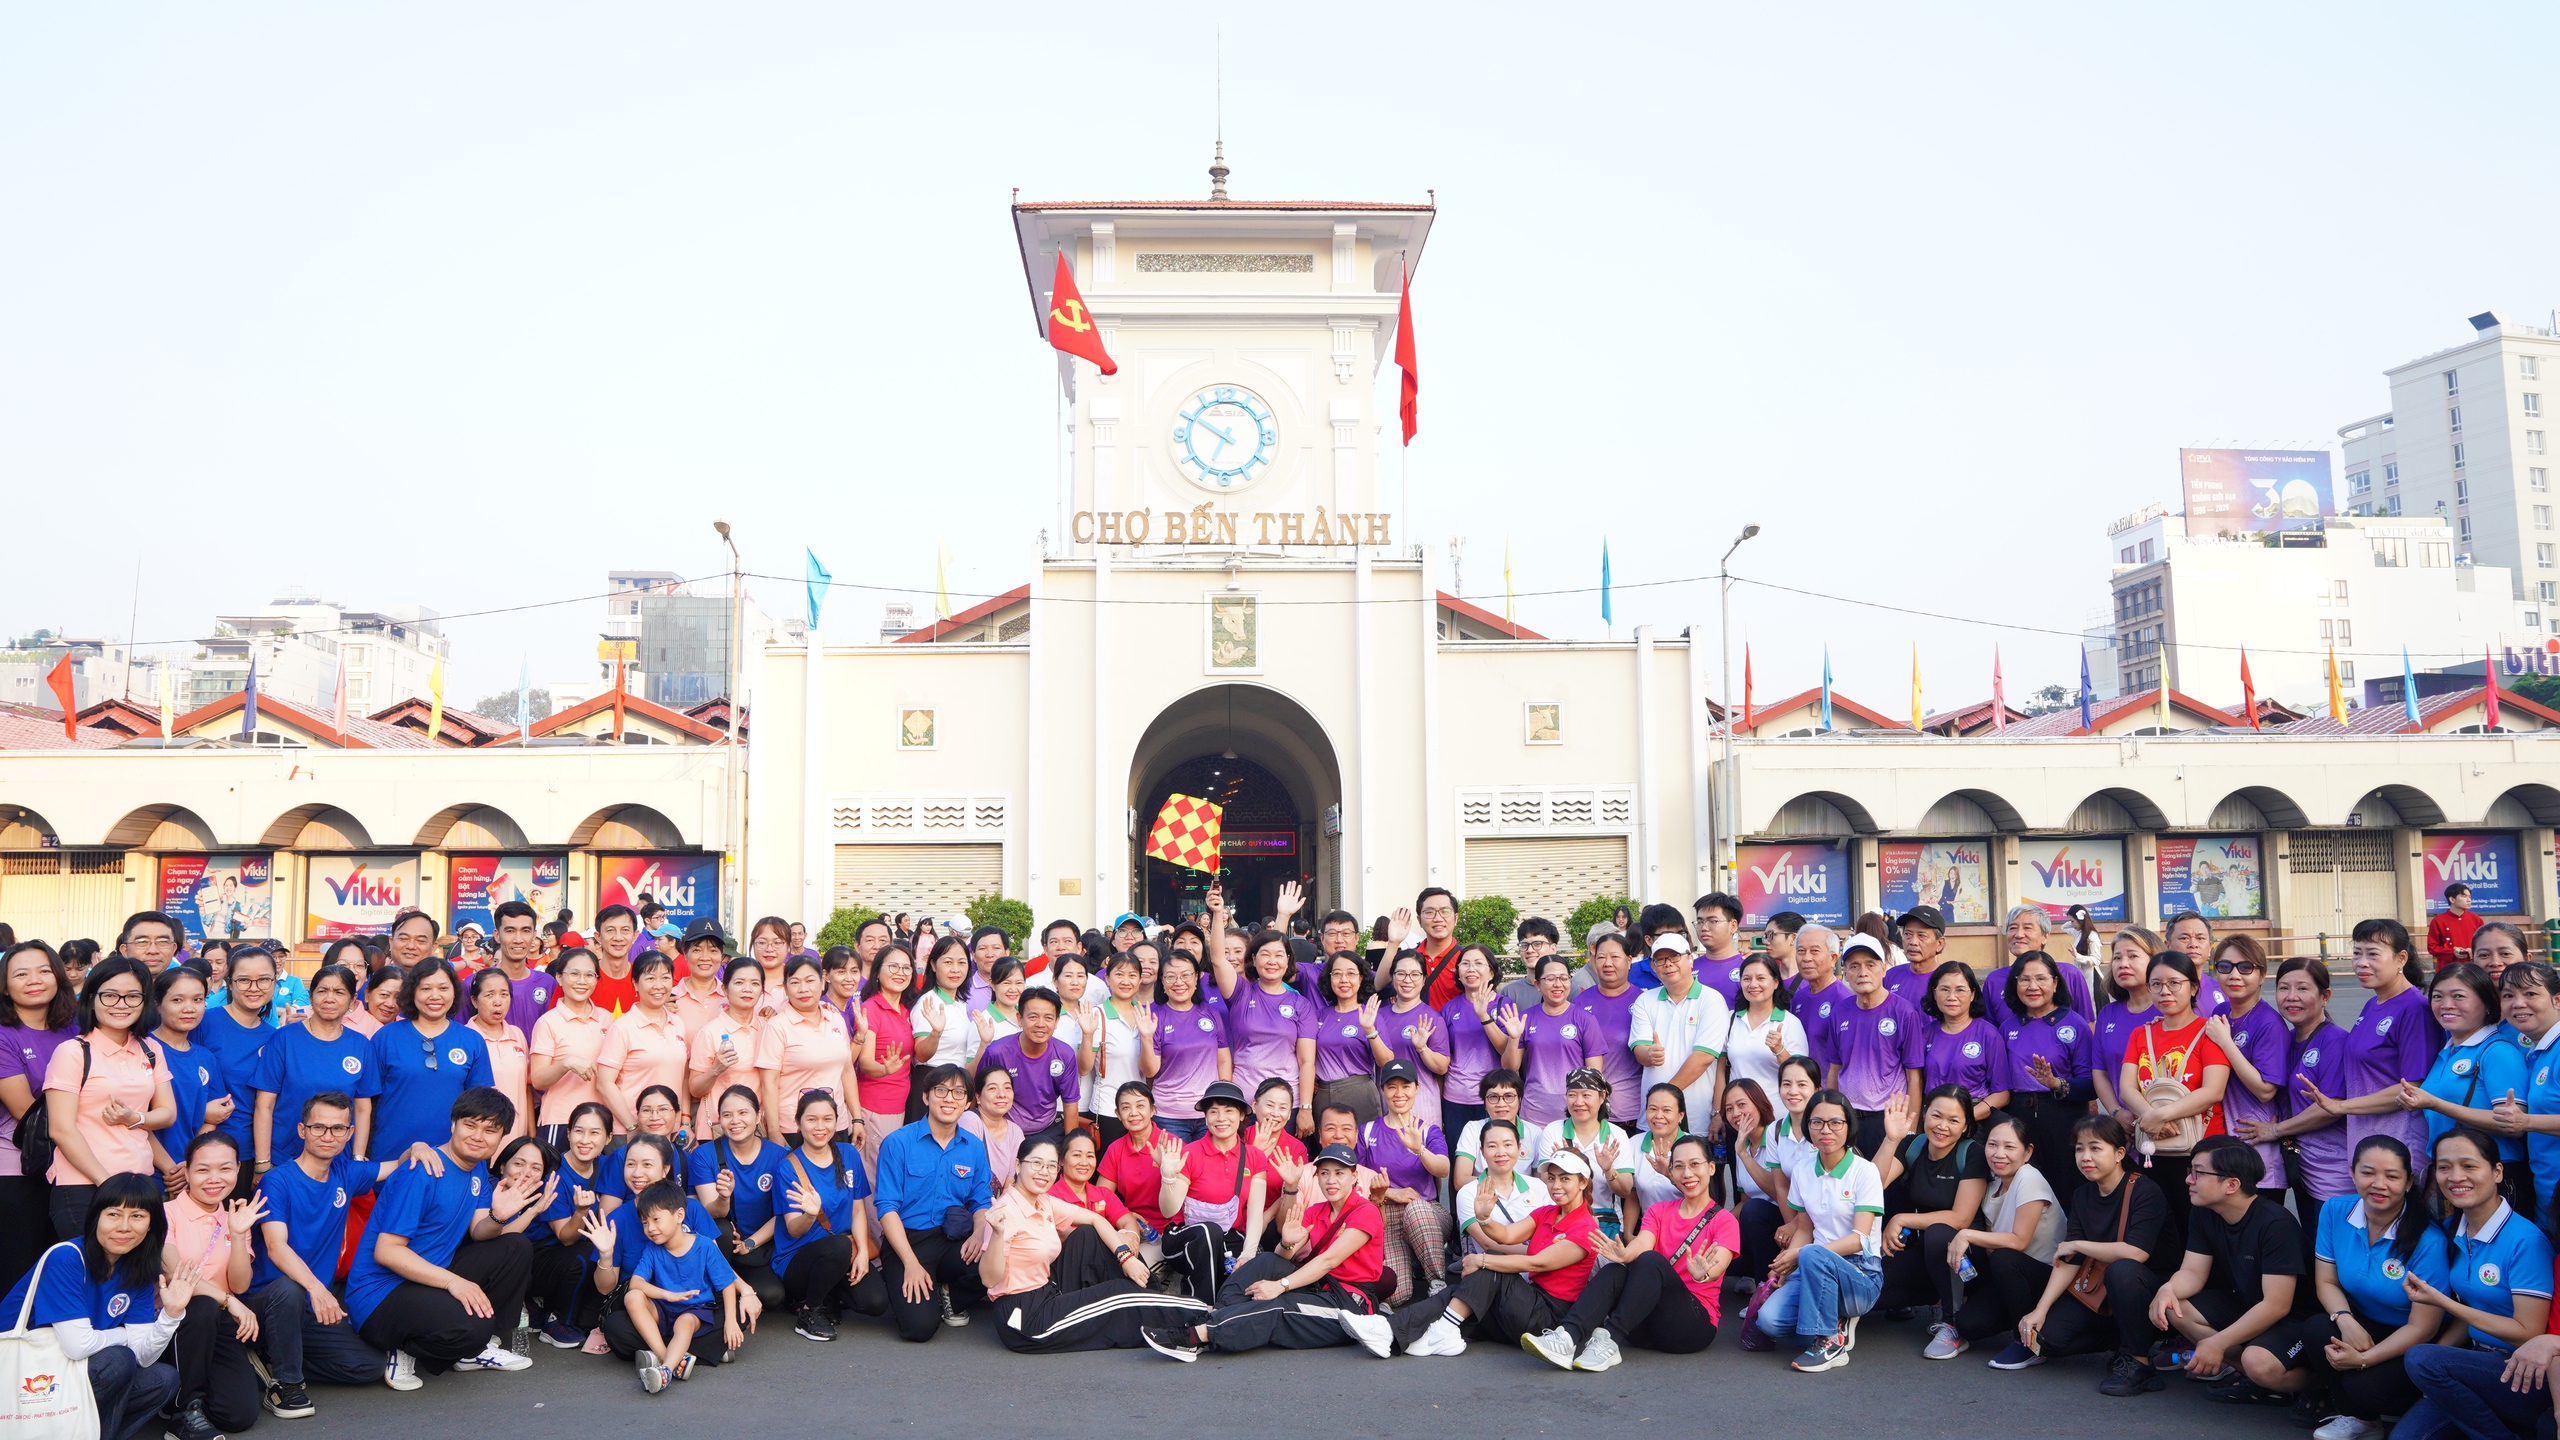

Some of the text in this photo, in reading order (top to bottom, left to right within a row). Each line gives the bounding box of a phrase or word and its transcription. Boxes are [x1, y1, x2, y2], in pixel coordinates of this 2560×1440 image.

[1215, 387, 1237, 402] 12
[1173, 426, 1189, 443] 9
[1261, 429, 1276, 446] 3
[1217, 472, 1231, 487] 6
[2204, 481, 2223, 490] PHONG
[2192, 492, 2211, 502] KHÔNG
[2225, 493, 2236, 502] HẠN
[2215, 504, 2230, 512] 2026
[1072, 501, 1391, 548] CHỢ BẾN THÀNH
[2373, 528, 2410, 537] HOTEL
[2424, 528, 2446, 537] LAC
[2353, 815, 2361, 825] 16
[52, 836, 58, 846] 2
[1227, 839, 1247, 847] CHÀO
[1248, 839, 1262, 847] QUÝ
[1263, 839, 1288, 847] KHÁCH
[1946, 844, 1979, 864] Vikki
[2219, 839, 2252, 859] Vikki
[1885, 857, 1916, 865] Ứng lương
[2031, 846, 2103, 888] Vikki
[2428, 840, 2497, 880] Vikki
[241, 862, 267, 877] Vikki
[533, 861, 559, 876] Vikki
[1751, 851, 1827, 894] Vikki
[1885, 866, 1900, 874] 0%
[176, 885, 190, 894] 0đ
[325, 862, 402, 906] Vikki
[616, 862, 696, 906] Vikki
[1788, 896, 1809, 904] Digital
[704, 921, 713, 931] A
